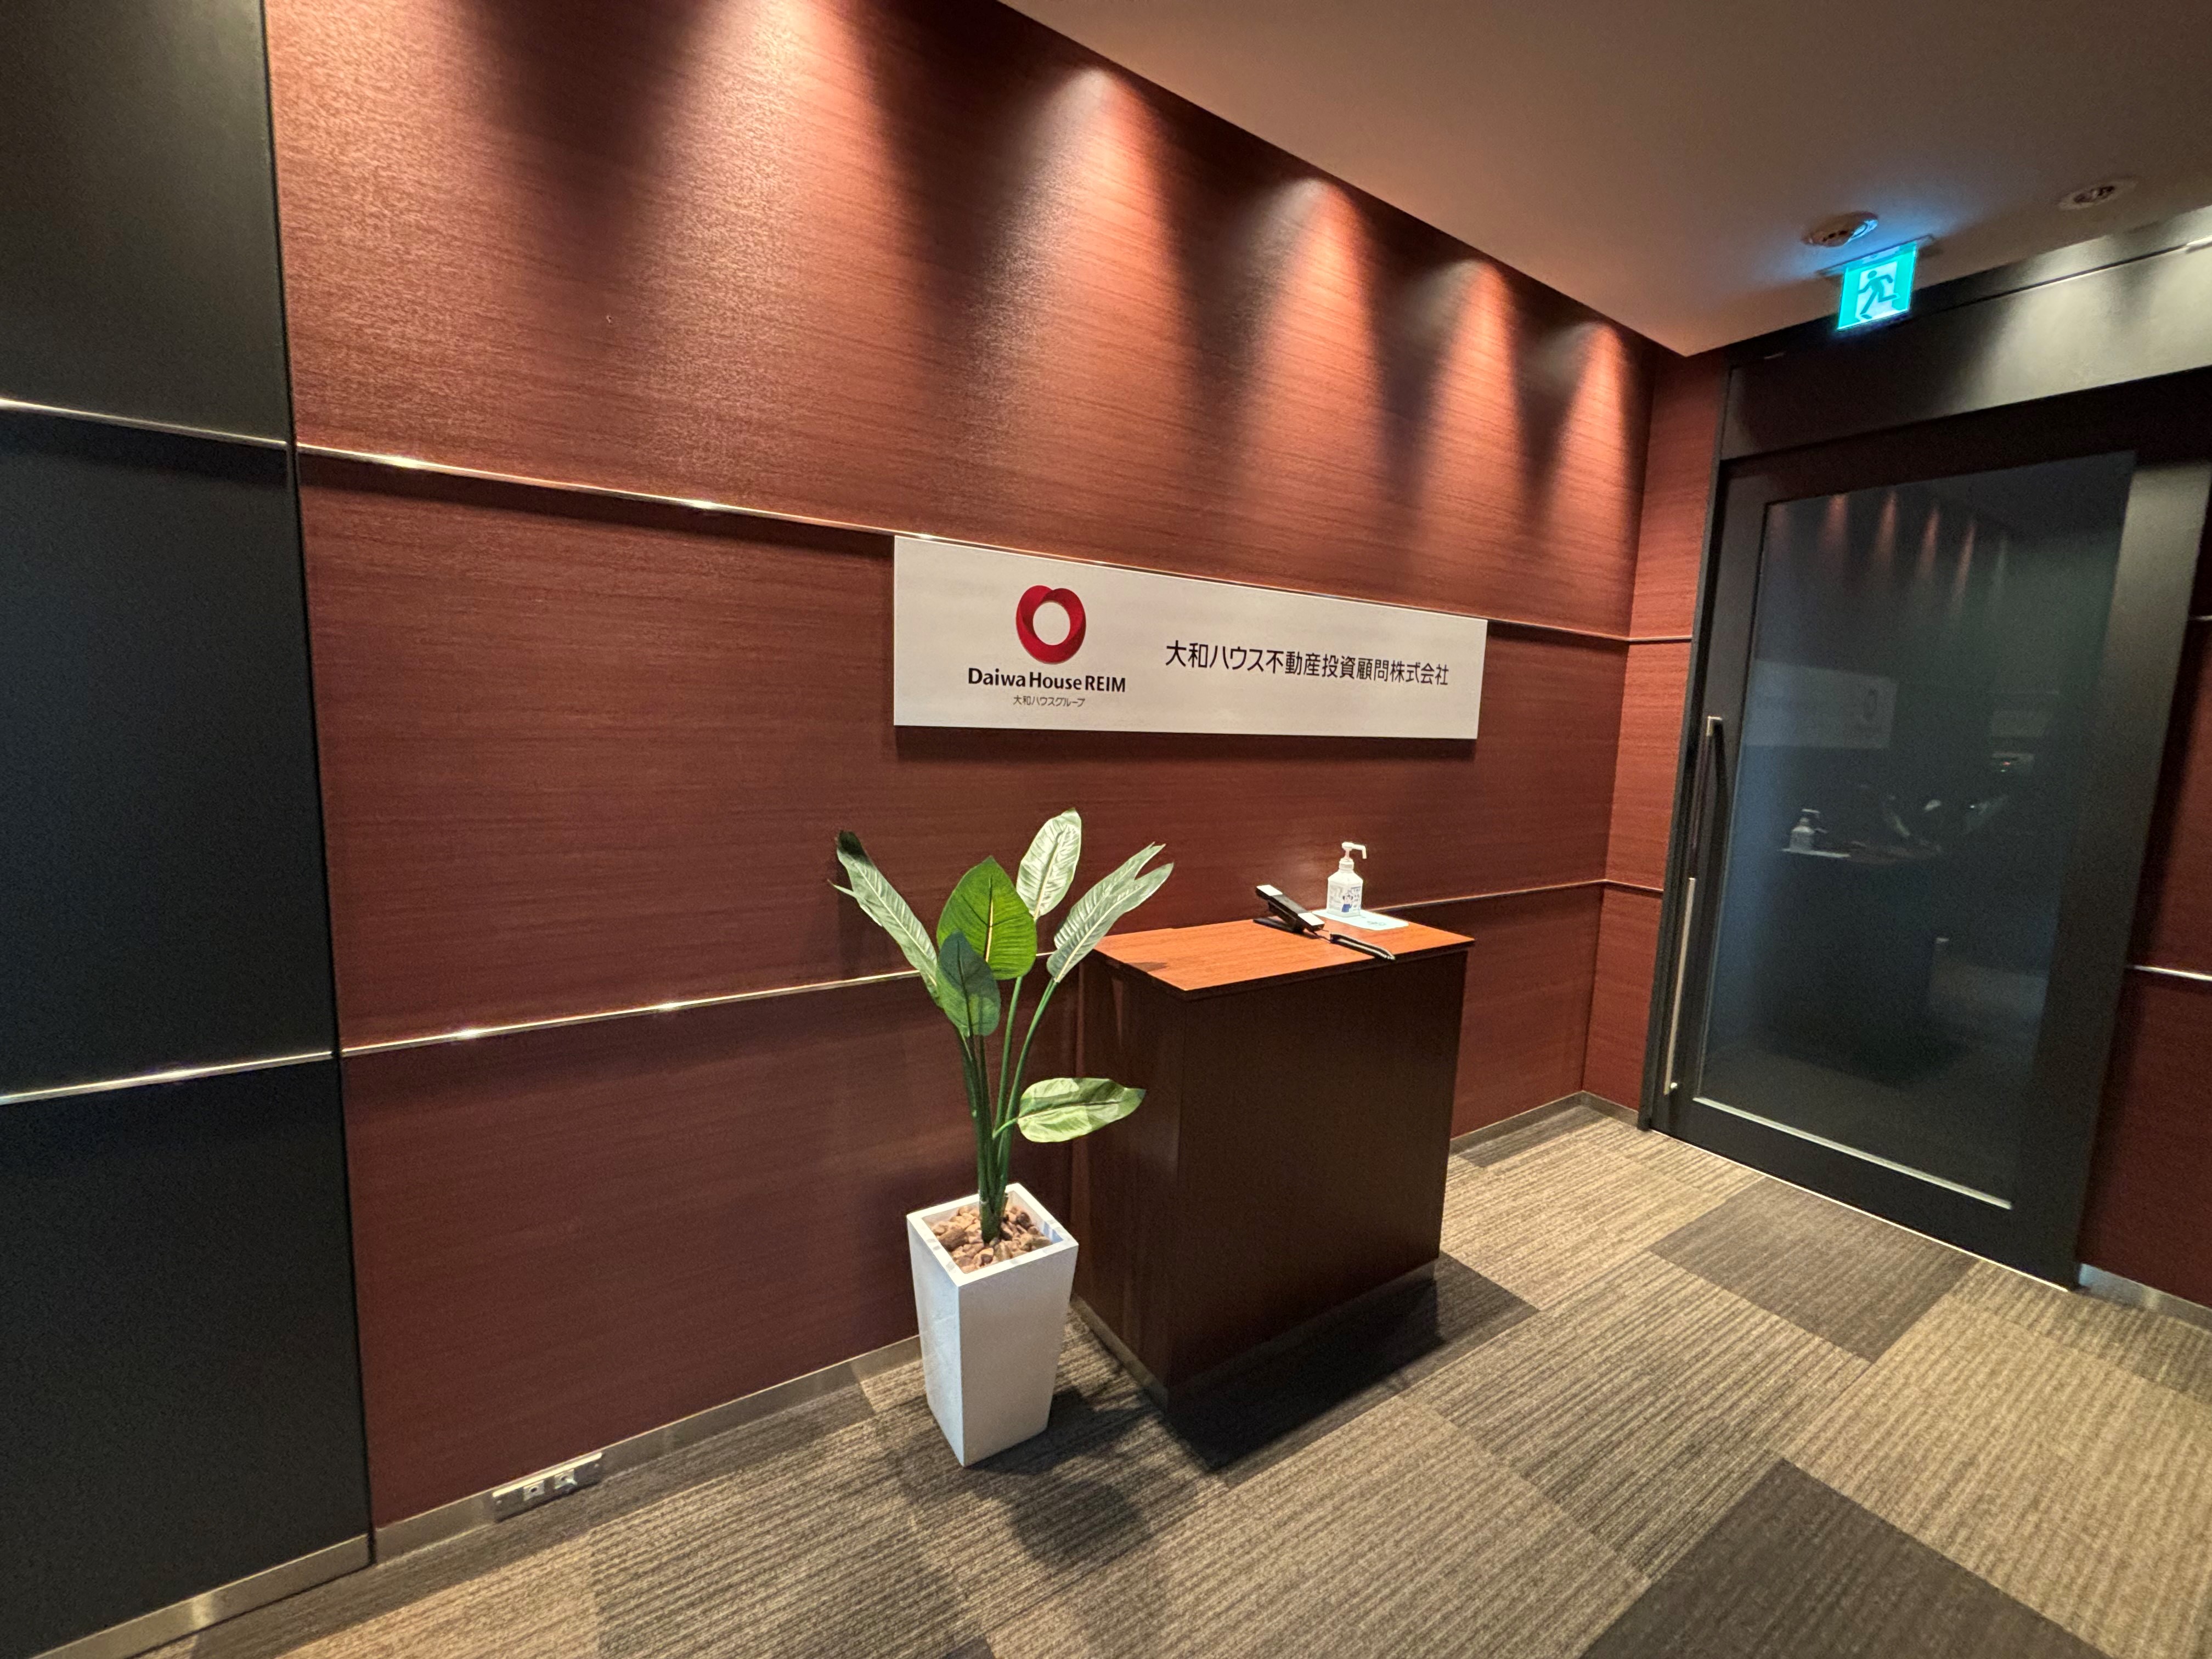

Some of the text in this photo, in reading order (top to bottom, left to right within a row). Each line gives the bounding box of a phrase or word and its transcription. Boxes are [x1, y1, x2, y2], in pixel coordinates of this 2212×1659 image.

[1165, 640, 1449, 686] 大和ハウス不動産投資顧問株式会社
[968, 667, 1126, 693] Daiwa House REIM
[1013, 695, 1086, 707] 大和ハウスグループ
